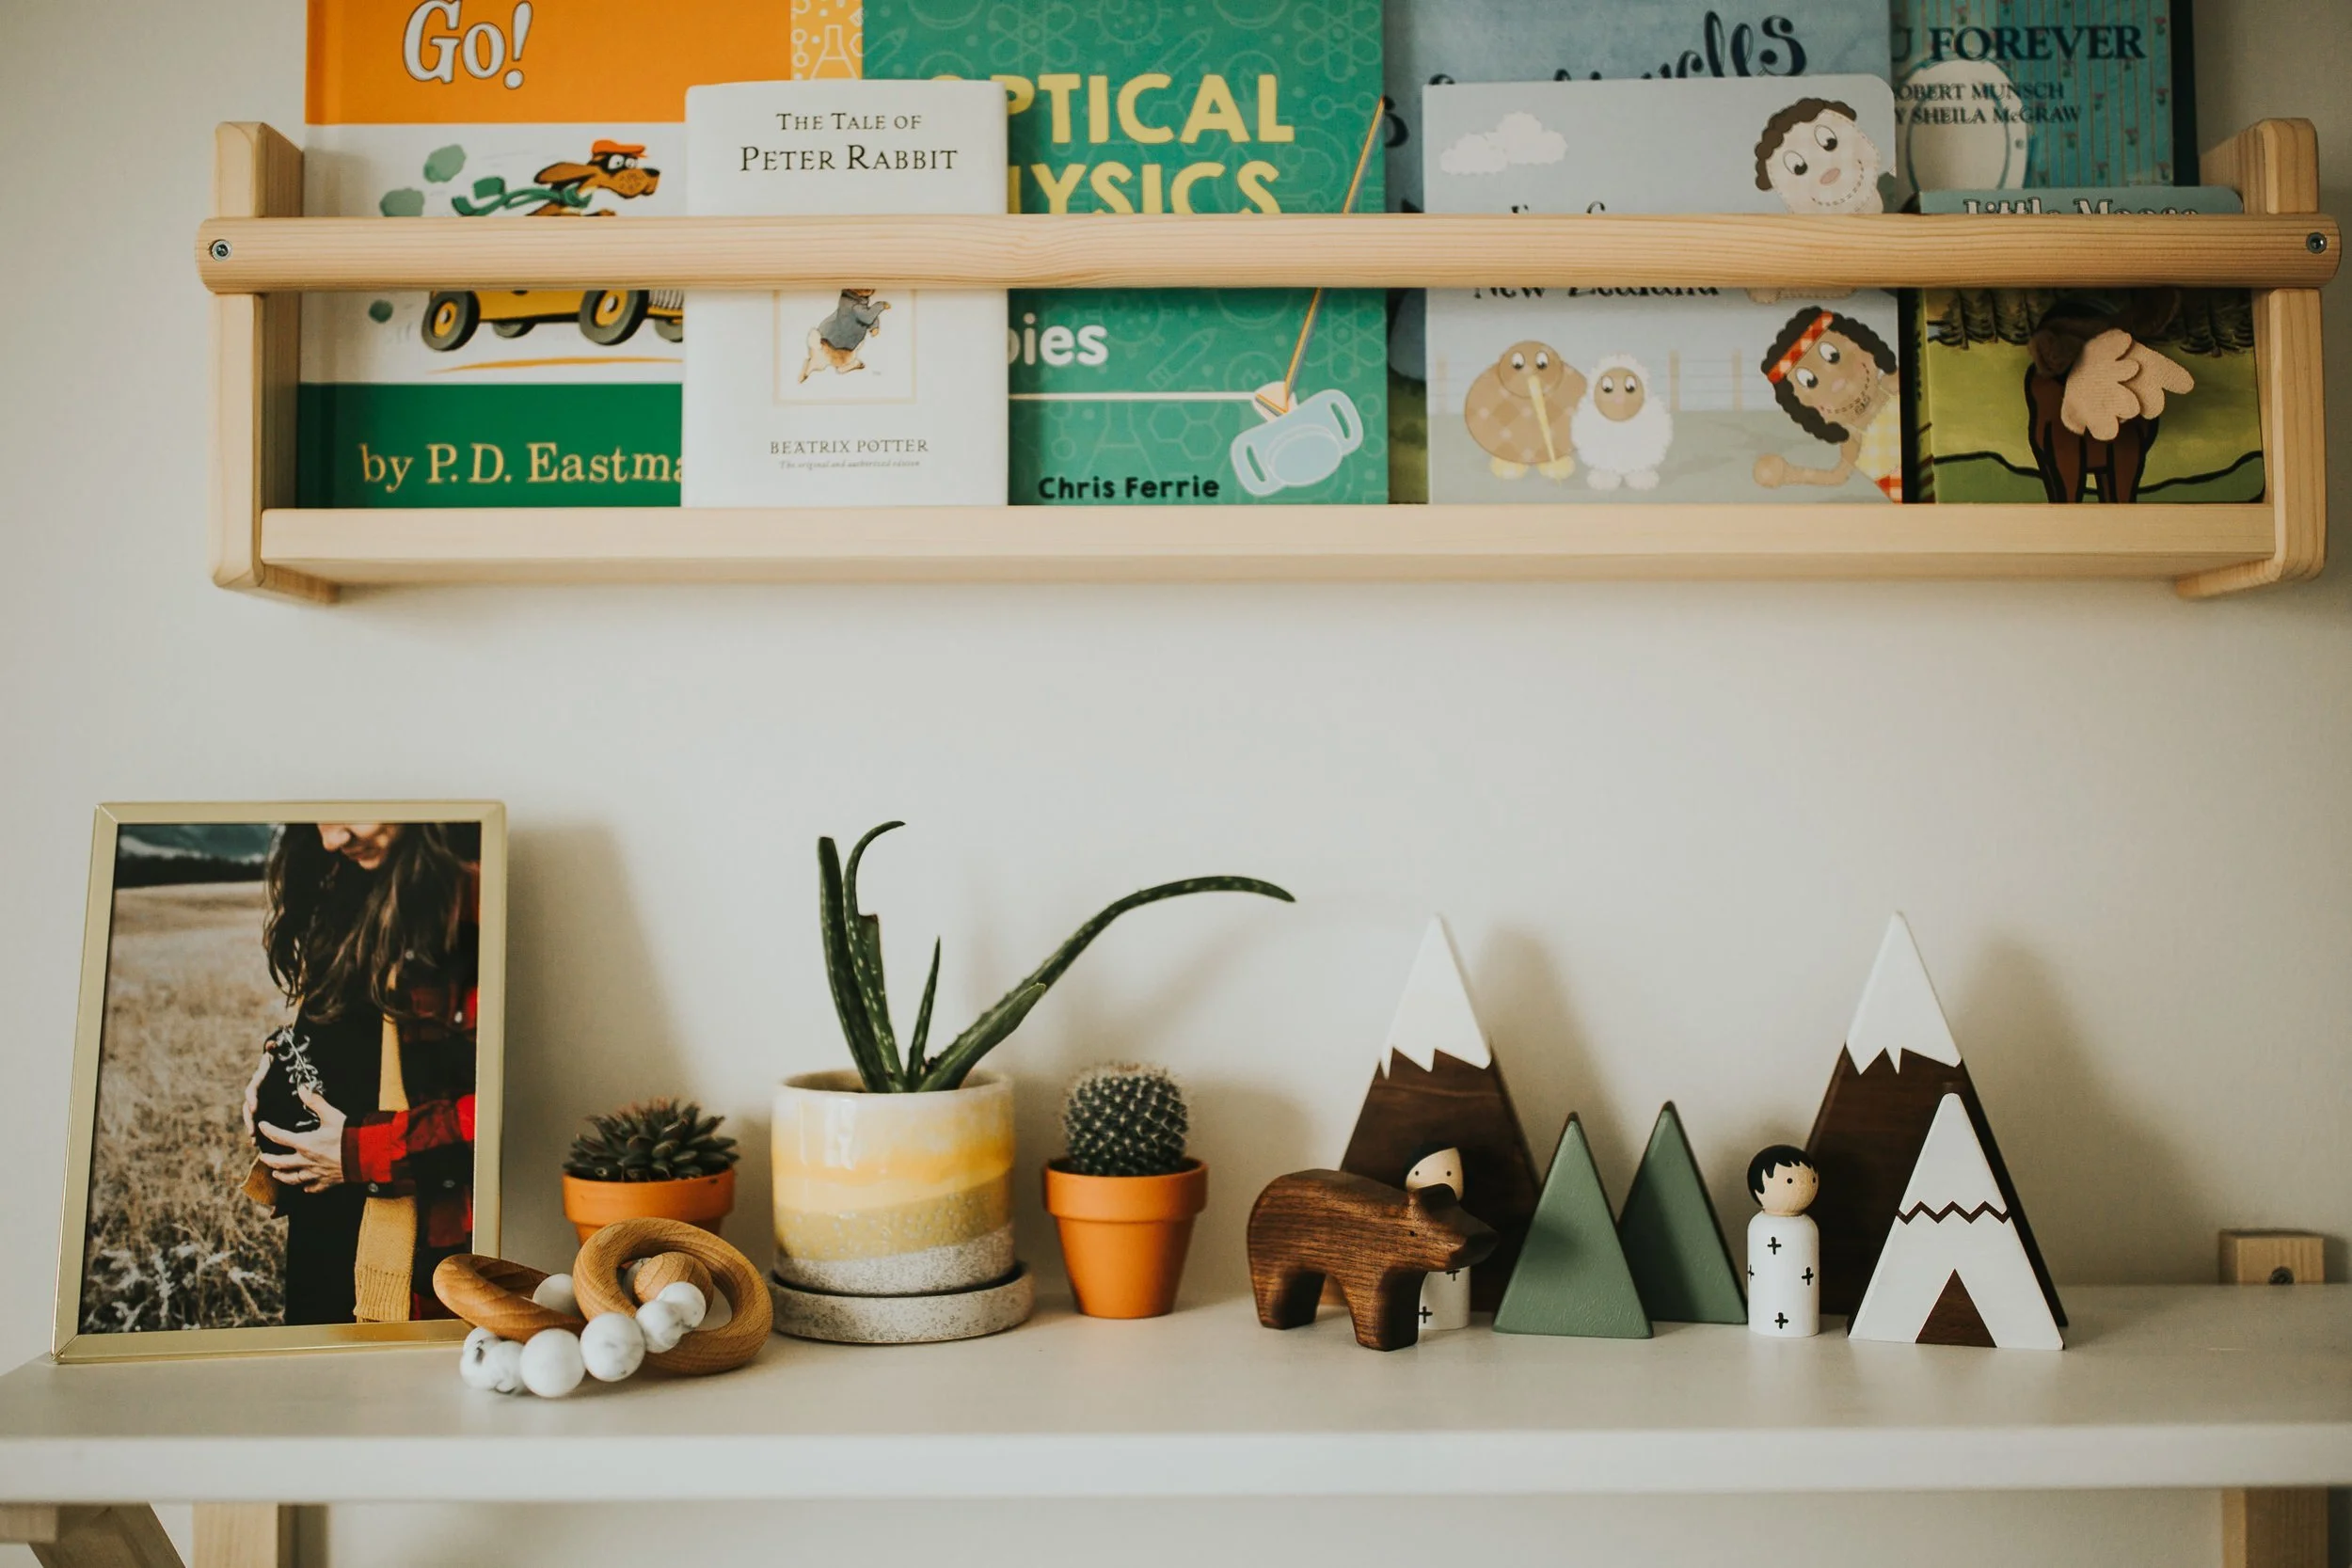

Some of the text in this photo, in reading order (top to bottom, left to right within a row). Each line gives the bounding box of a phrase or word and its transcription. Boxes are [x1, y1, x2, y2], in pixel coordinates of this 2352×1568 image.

[403, 0, 533, 89] Go!
[1928, 25, 2146, 61] FOREVER
[930, 72, 1295, 144] PTICAL
[1972, 81, 2065, 101] MUNSCH
[1912, 106, 1987, 124] SHEILA
[1994, 105, 2082, 124] McGRAW
[1008, 160, 1282, 214] YSICS
[770, 438, 930, 455] BEATRIX POTTER
[358, 443, 414, 493] by
[1038, 474, 1220, 499] Chris Ferrie
